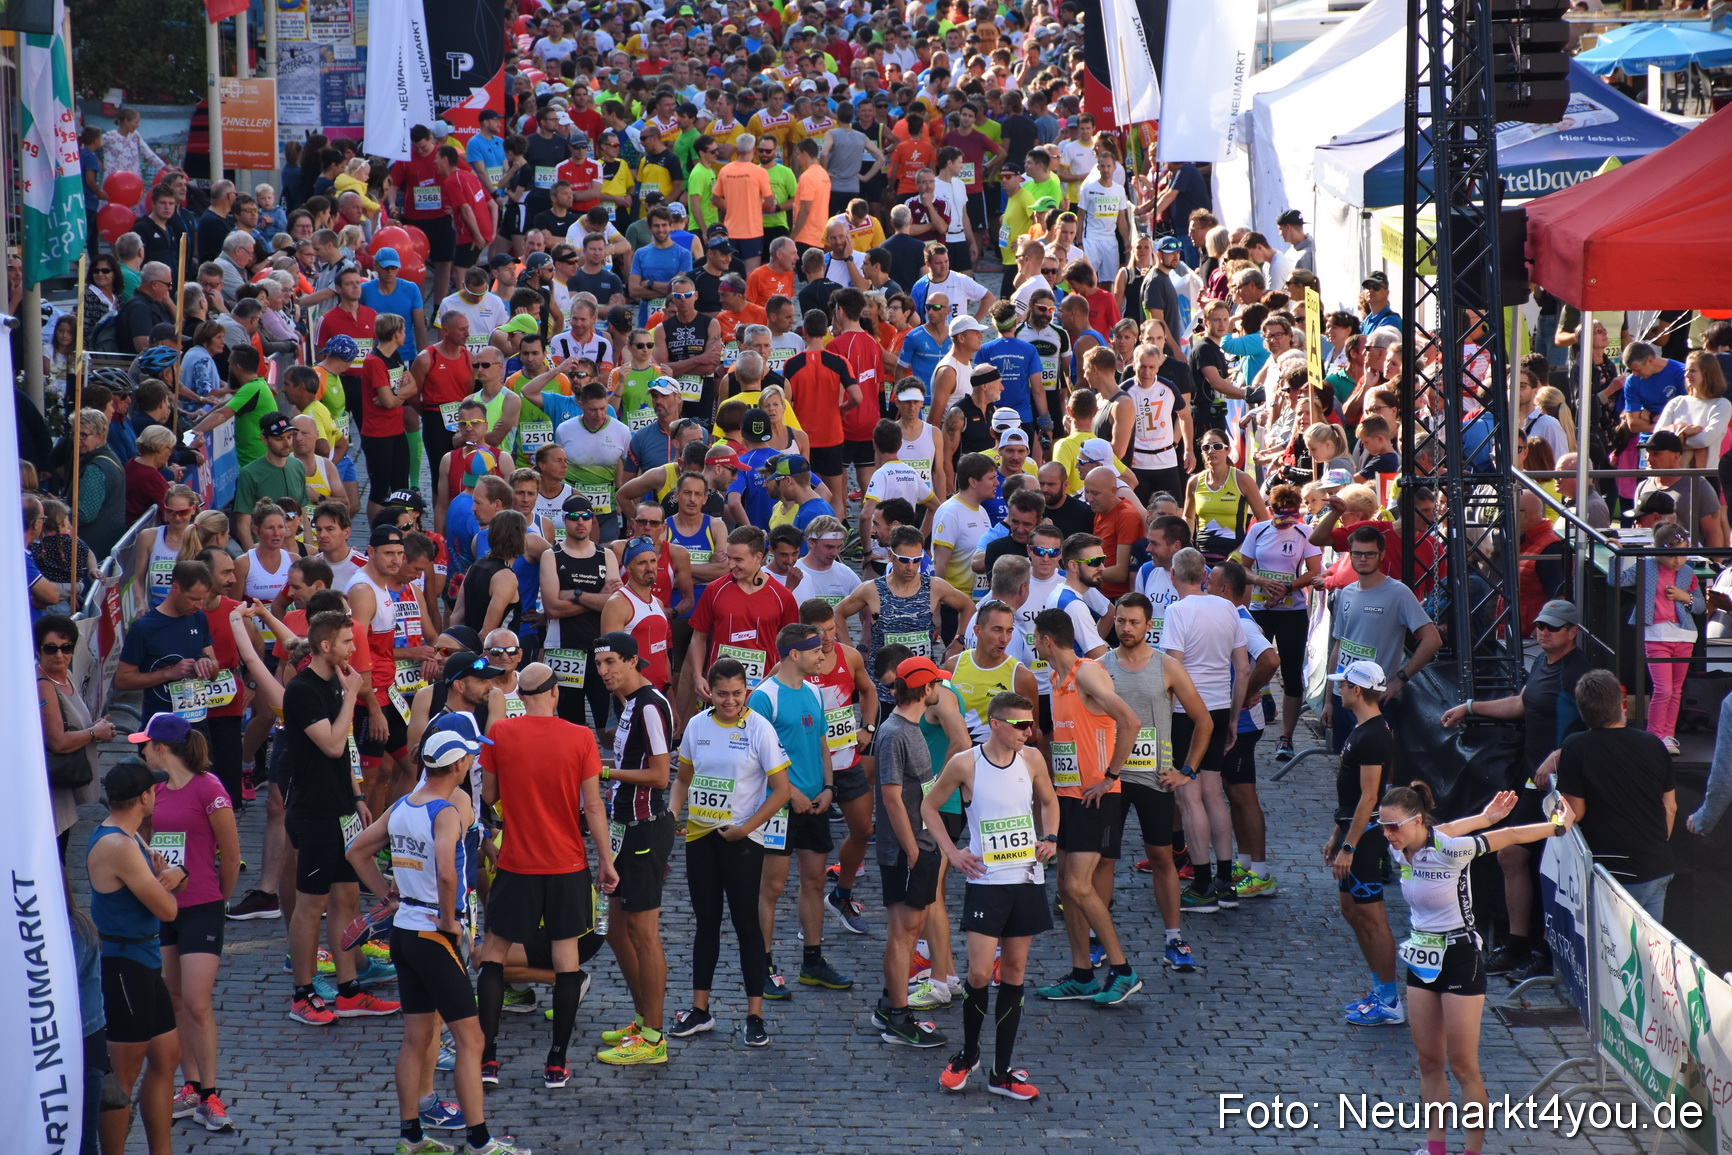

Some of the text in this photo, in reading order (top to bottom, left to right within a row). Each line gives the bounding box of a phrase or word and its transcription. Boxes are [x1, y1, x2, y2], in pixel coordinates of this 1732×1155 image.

[411, 19, 431, 83] NEUMARKT
[1231, 50, 1246, 116] NEUMARKT
[1500, 168, 1597, 194] ttelbaye
[417, 194, 438, 202] 2568
[466, 334, 490, 344] OCK
[1310, 322, 1318, 366] A
[726, 350, 738, 358] 21
[770, 350, 795, 359] OCK
[446, 413, 458, 423] 26
[525, 432, 554, 443] 2510
[689, 551, 712, 560] OCK
[156, 574, 173, 586] 25
[1258, 571, 1292, 580] BOCK
[887, 634, 928, 644] BOCK
[1146, 632, 1160, 644] 25
[722, 647, 760, 660] BOCK
[1341, 642, 1372, 657] BOCK
[548, 658, 580, 674] 1232
[178, 692, 206, 710] 243
[828, 721, 852, 738] 386
[1137, 729, 1151, 740] CK
[1053, 744, 1072, 754] BOCK
[1132, 744, 1151, 756] 40
[1054, 757, 1074, 771] 1362
[694, 778, 731, 790] BOCK
[693, 790, 727, 808] 1367
[696, 810, 724, 820] NANCY
[345, 818, 361, 842] 2210
[984, 818, 1030, 832] BOCK
[989, 832, 1028, 851] 1163
[994, 851, 1027, 862] MARKUS
[1442, 848, 1473, 859] AMBERG
[1413, 870, 1451, 880] AMBERG
[12, 869, 64, 1072] NEUMARKT
